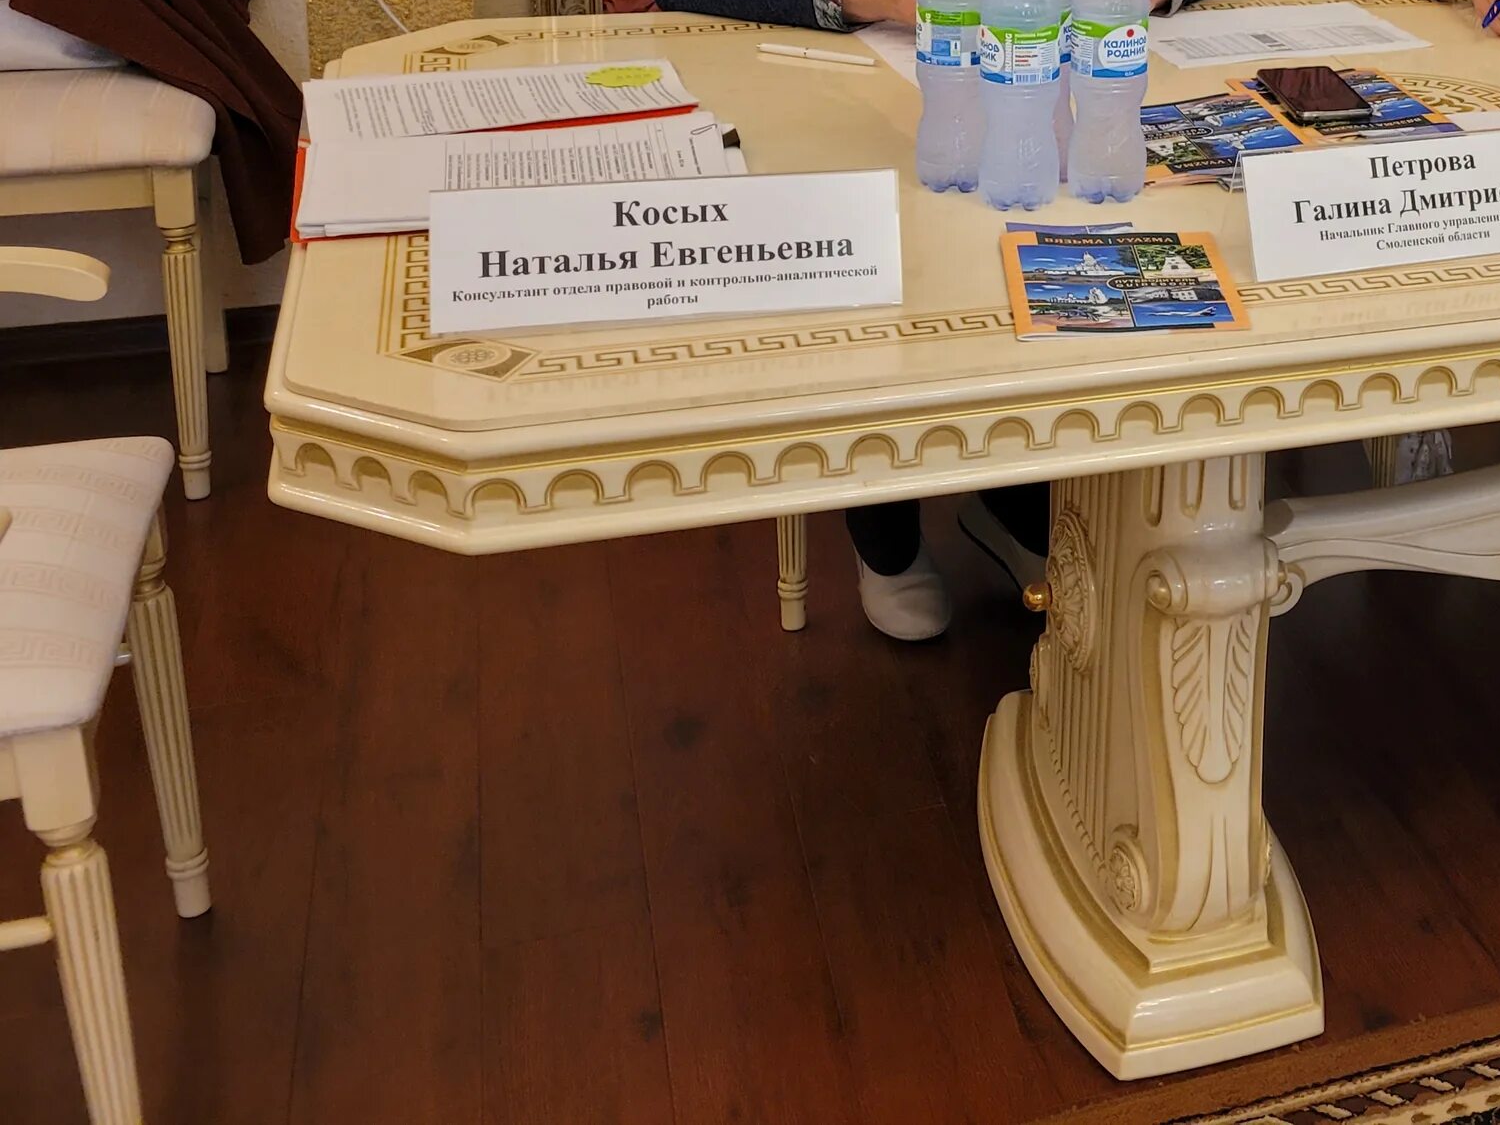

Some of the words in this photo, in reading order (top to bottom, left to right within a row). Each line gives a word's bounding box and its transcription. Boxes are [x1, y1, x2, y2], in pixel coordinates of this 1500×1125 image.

[1107, 46, 1146, 58] РОДНИК
[1367, 154, 1477, 181] Петрова
[612, 200, 729, 228] Косых
[1292, 198, 1393, 224] Галина
[1044, 237, 1105, 245] ВЯЗЬМА
[1319, 226, 1385, 242] Начальник
[1387, 220, 1440, 234] Главного
[1376, 232, 1445, 251] Смоленской
[1448, 230, 1490, 242] области
[477, 250, 638, 279] Наталья
[650, 238, 854, 268] Евгеньевна
[452, 287, 550, 303] Консультант
[552, 284, 601, 296] отдела
[605, 277, 673, 295] правовой
[677, 279, 685, 288] и
[690, 266, 877, 286] контрольно-аналитической
[647, 294, 698, 310] работы
